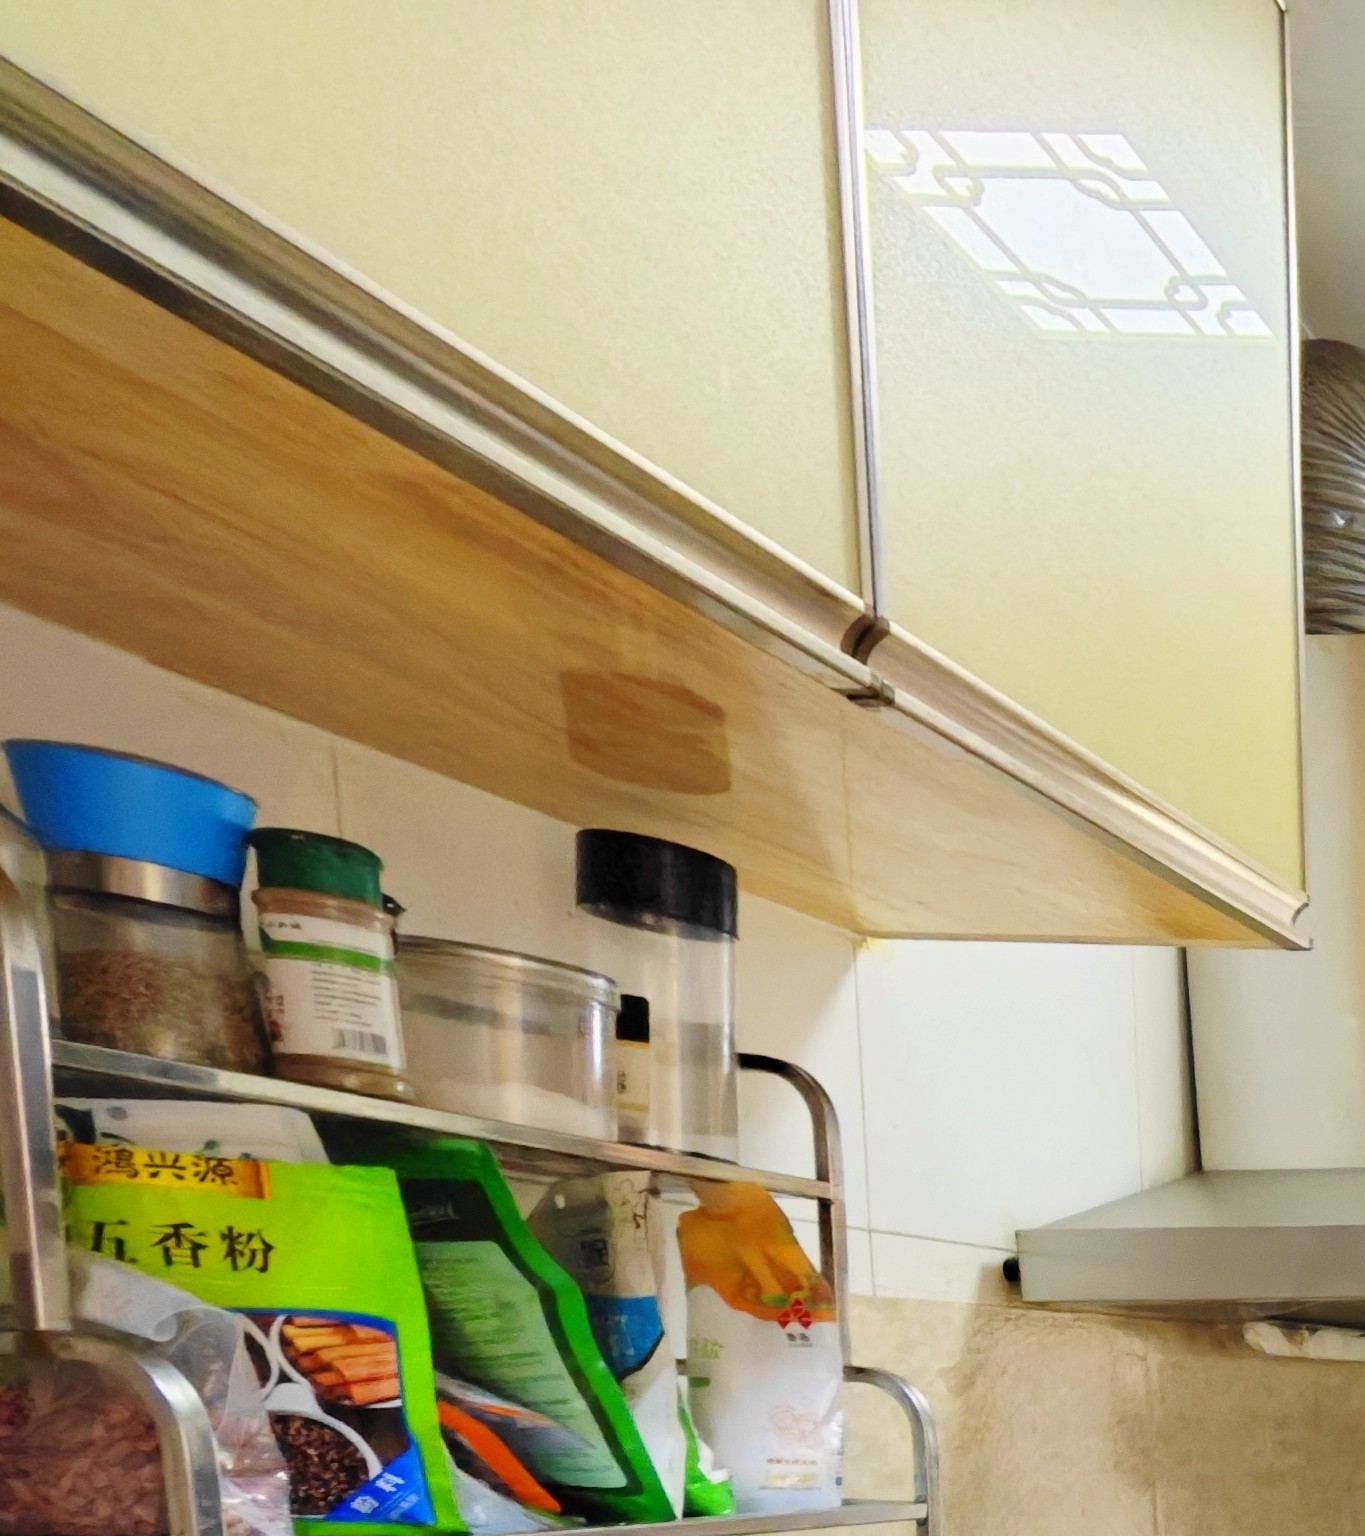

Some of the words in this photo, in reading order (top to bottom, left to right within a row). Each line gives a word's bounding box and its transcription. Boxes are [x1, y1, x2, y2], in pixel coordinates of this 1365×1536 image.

[96, 1147, 238, 1187] 鸿兴源
[90, 1219, 275, 1274] 五香粉
